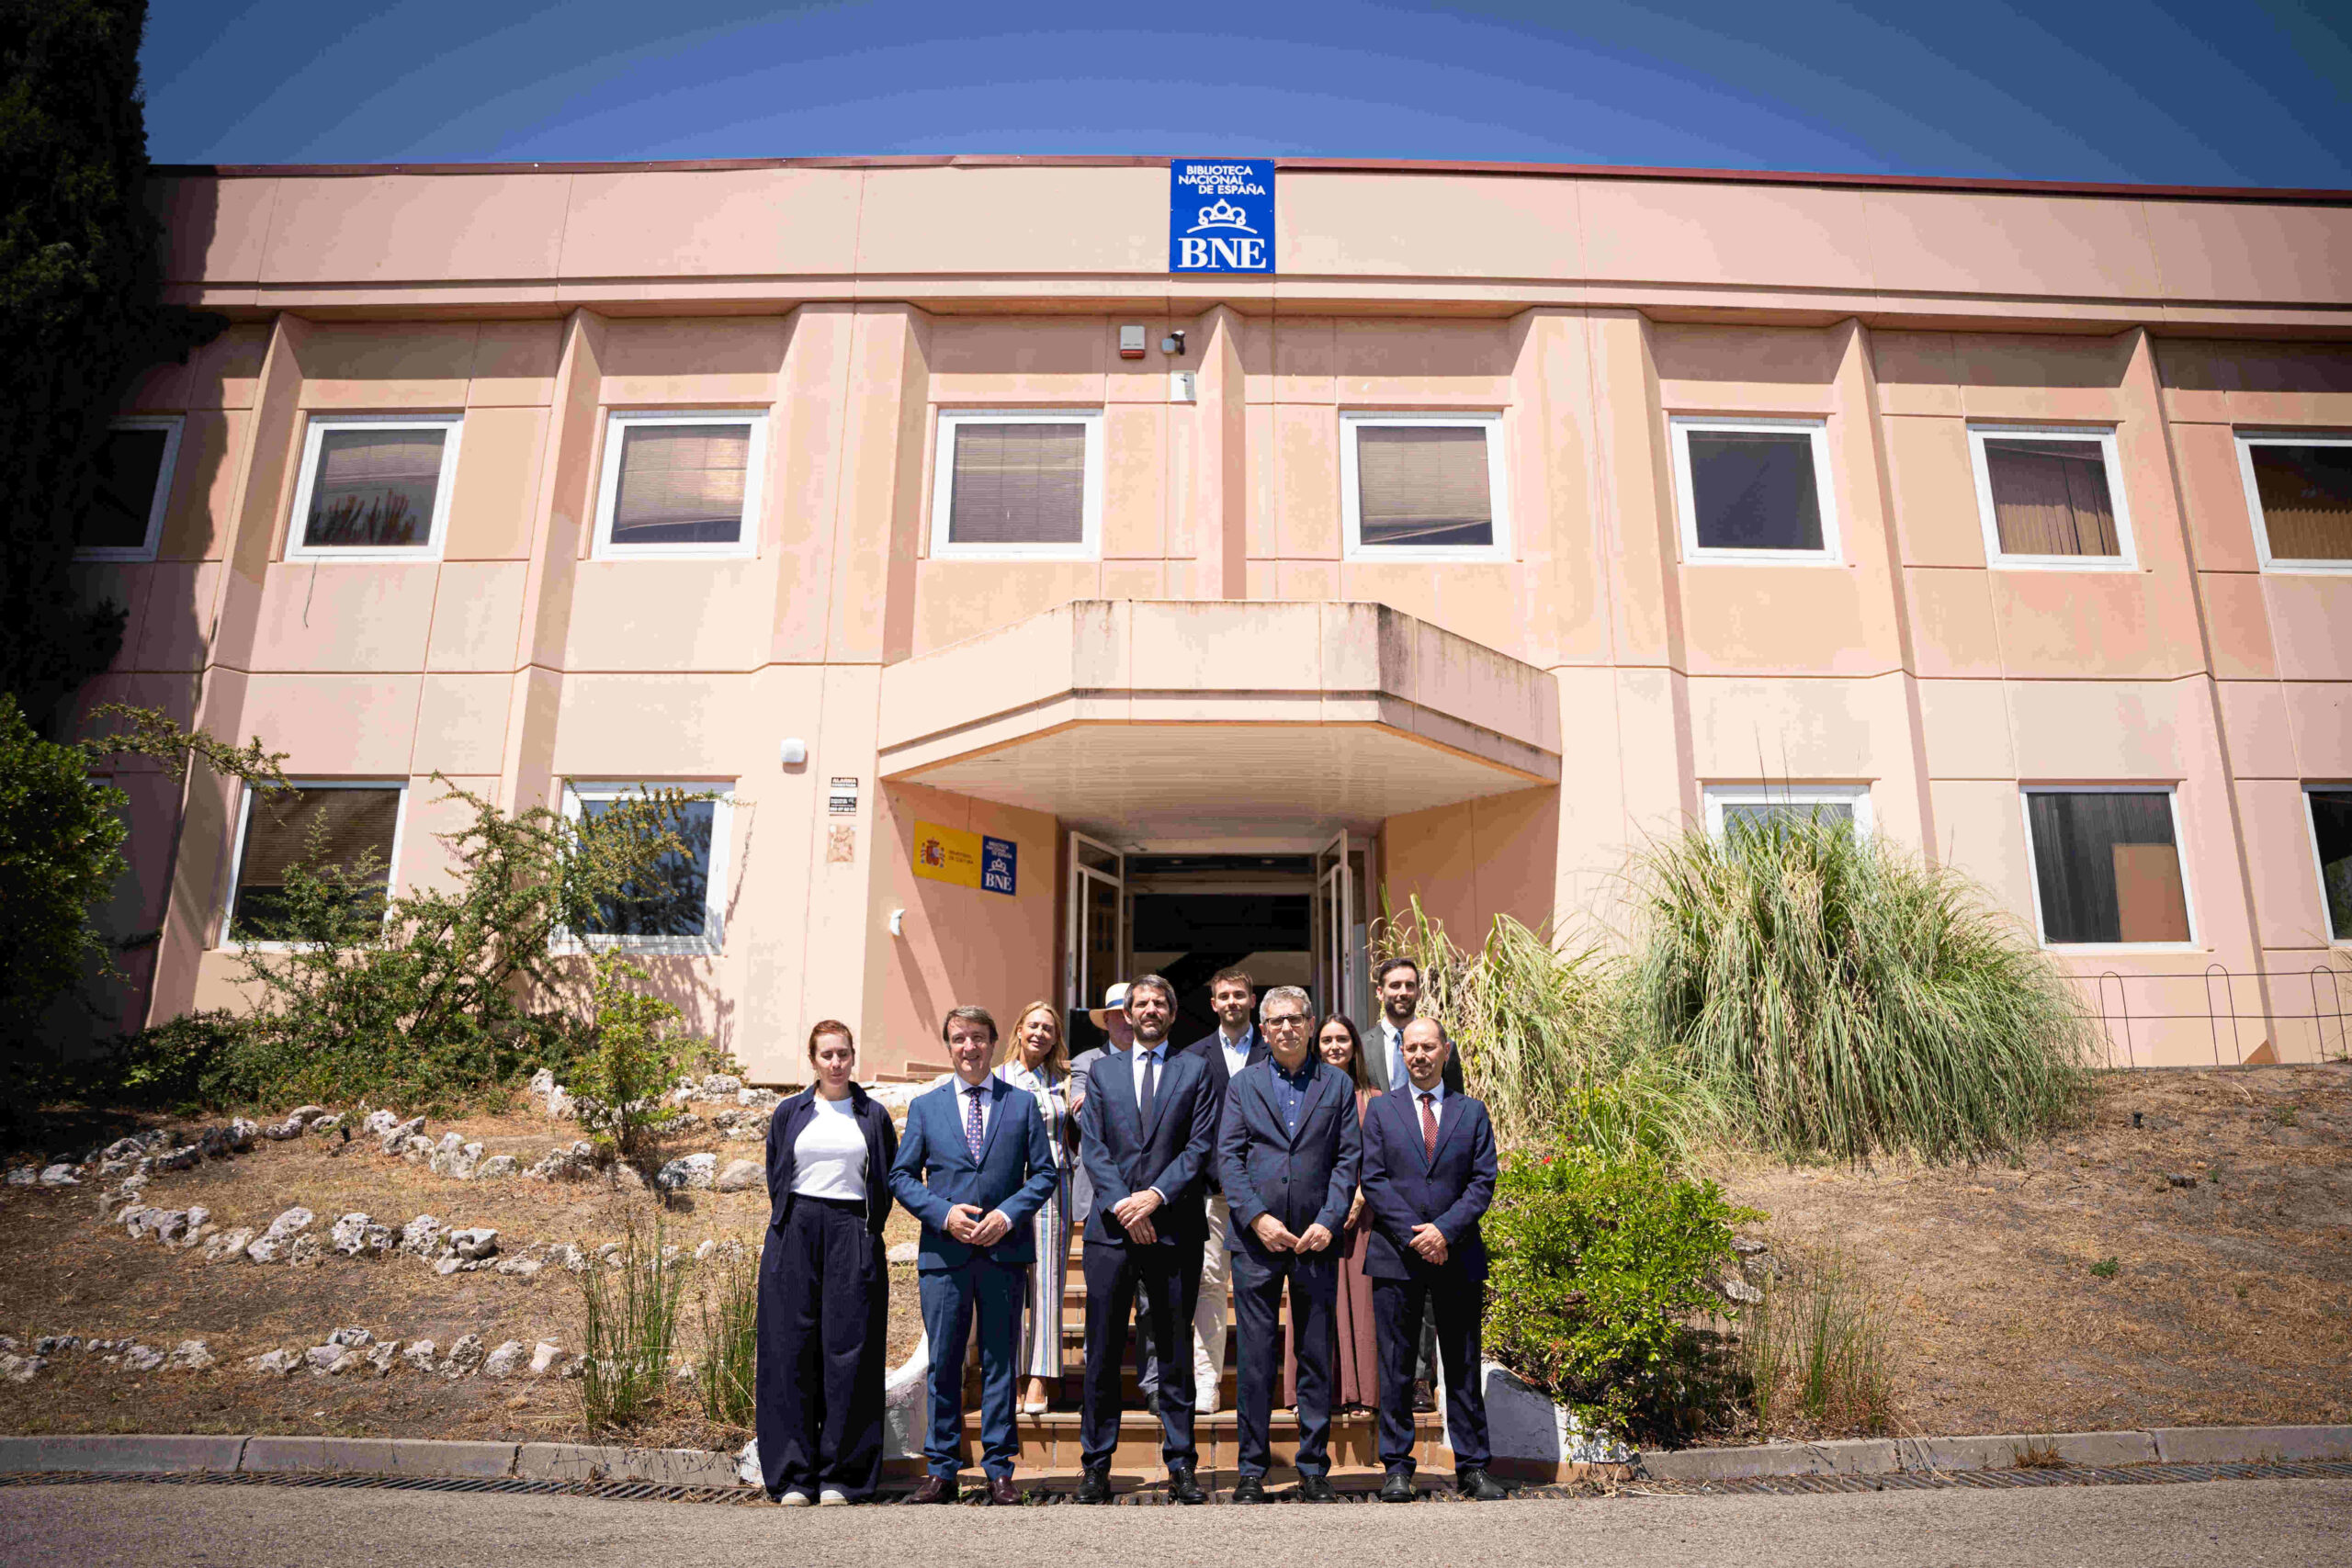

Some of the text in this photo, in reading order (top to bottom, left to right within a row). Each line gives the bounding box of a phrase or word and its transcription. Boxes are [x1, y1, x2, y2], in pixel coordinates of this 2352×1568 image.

[1186, 165, 1253, 175] BIBLIOTECA
[1178, 175, 1244, 185] NACIONAL
[1198, 183, 1266, 195] DE ESPAÑA
[1177, 237, 1267, 269] BNE
[985, 873, 1012, 891] BNE
